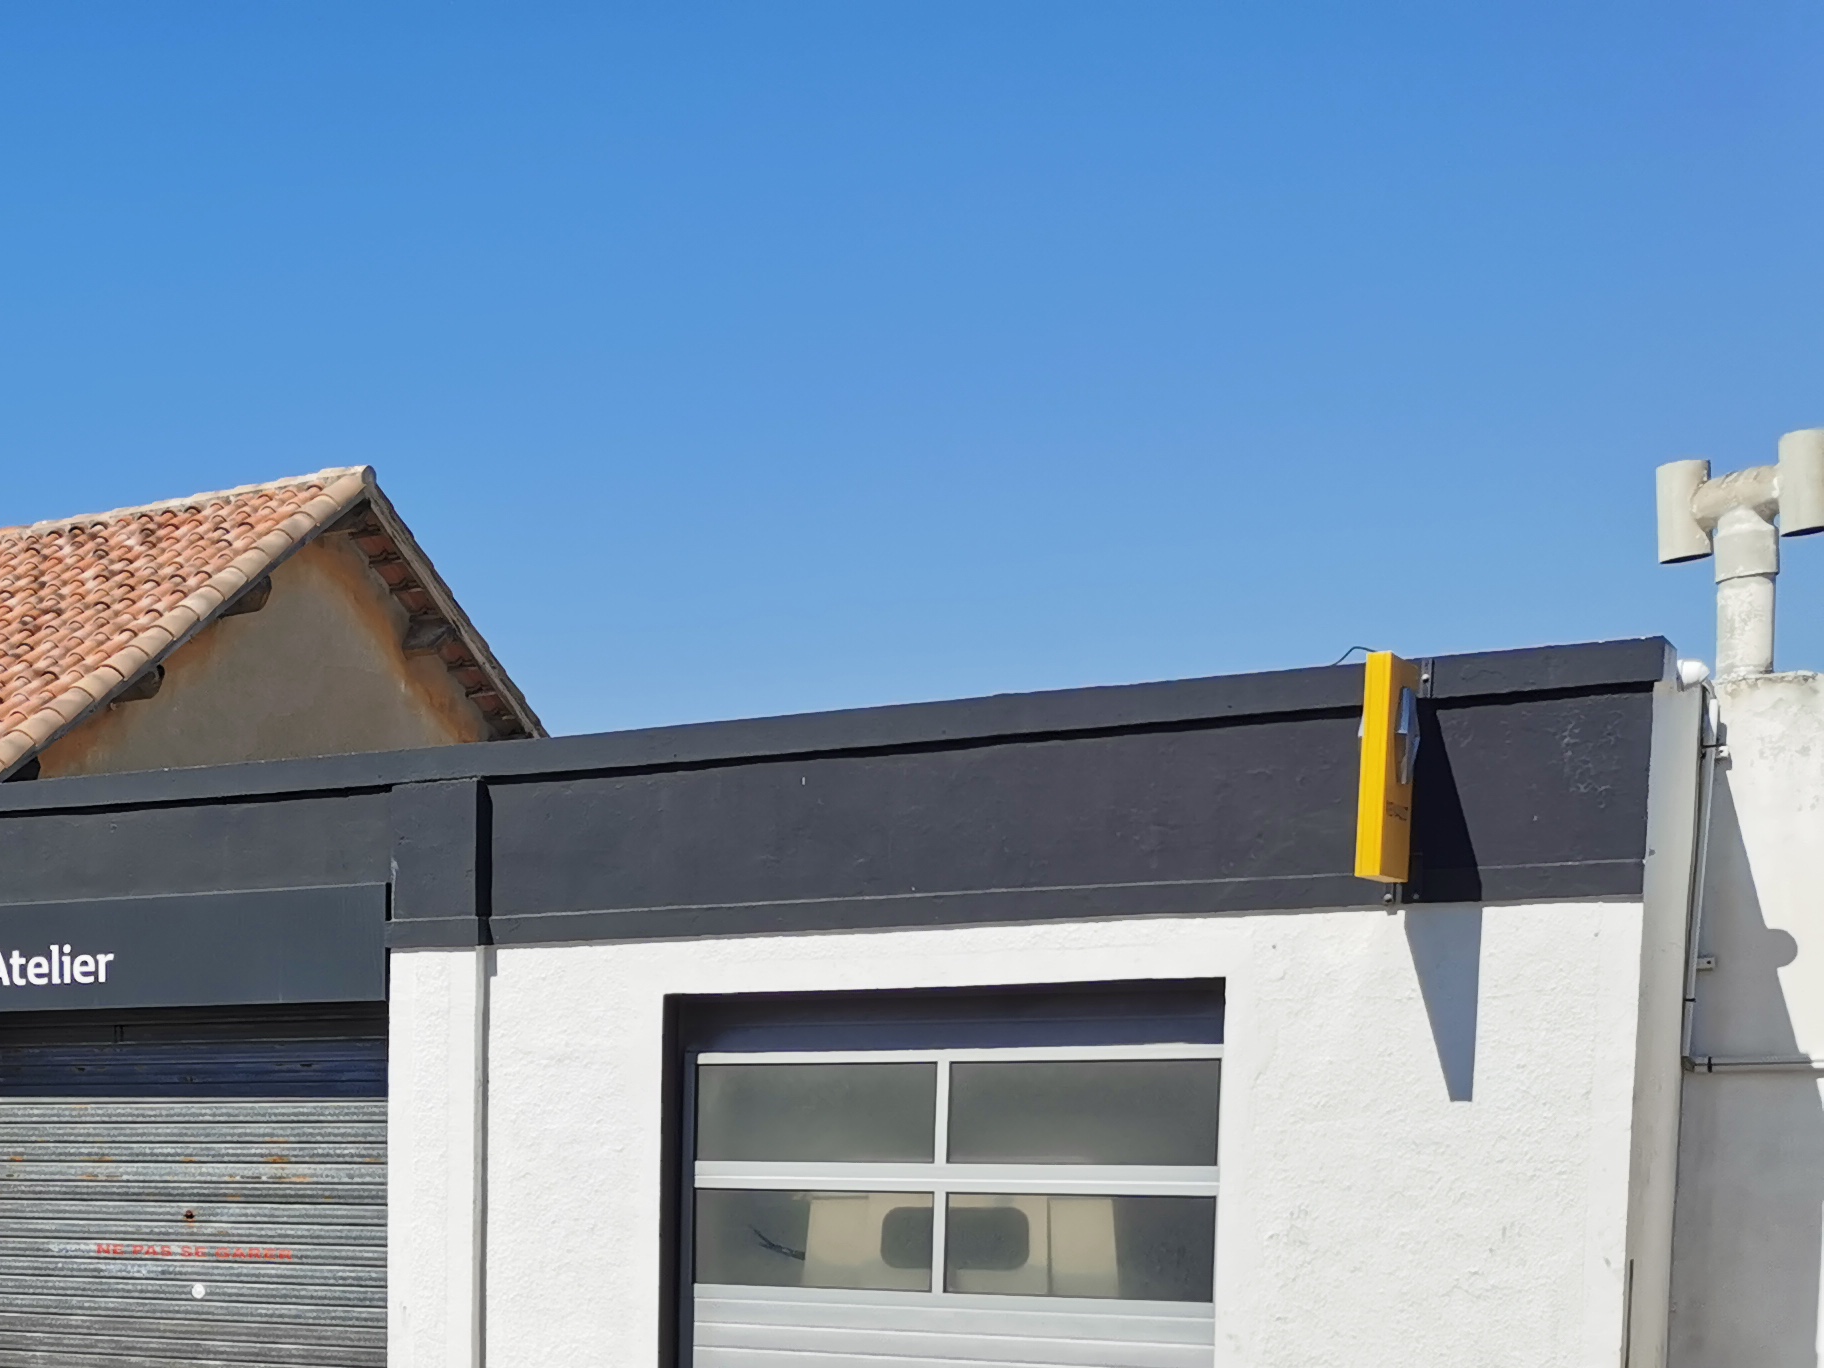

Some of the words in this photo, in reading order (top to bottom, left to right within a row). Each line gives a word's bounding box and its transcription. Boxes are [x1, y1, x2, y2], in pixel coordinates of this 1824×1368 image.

[96, 1244, 124, 1255] NE
[132, 1245, 173, 1257] PAS
[180, 1246, 207, 1258] SE
[215, 1247, 293, 1260] GARER
